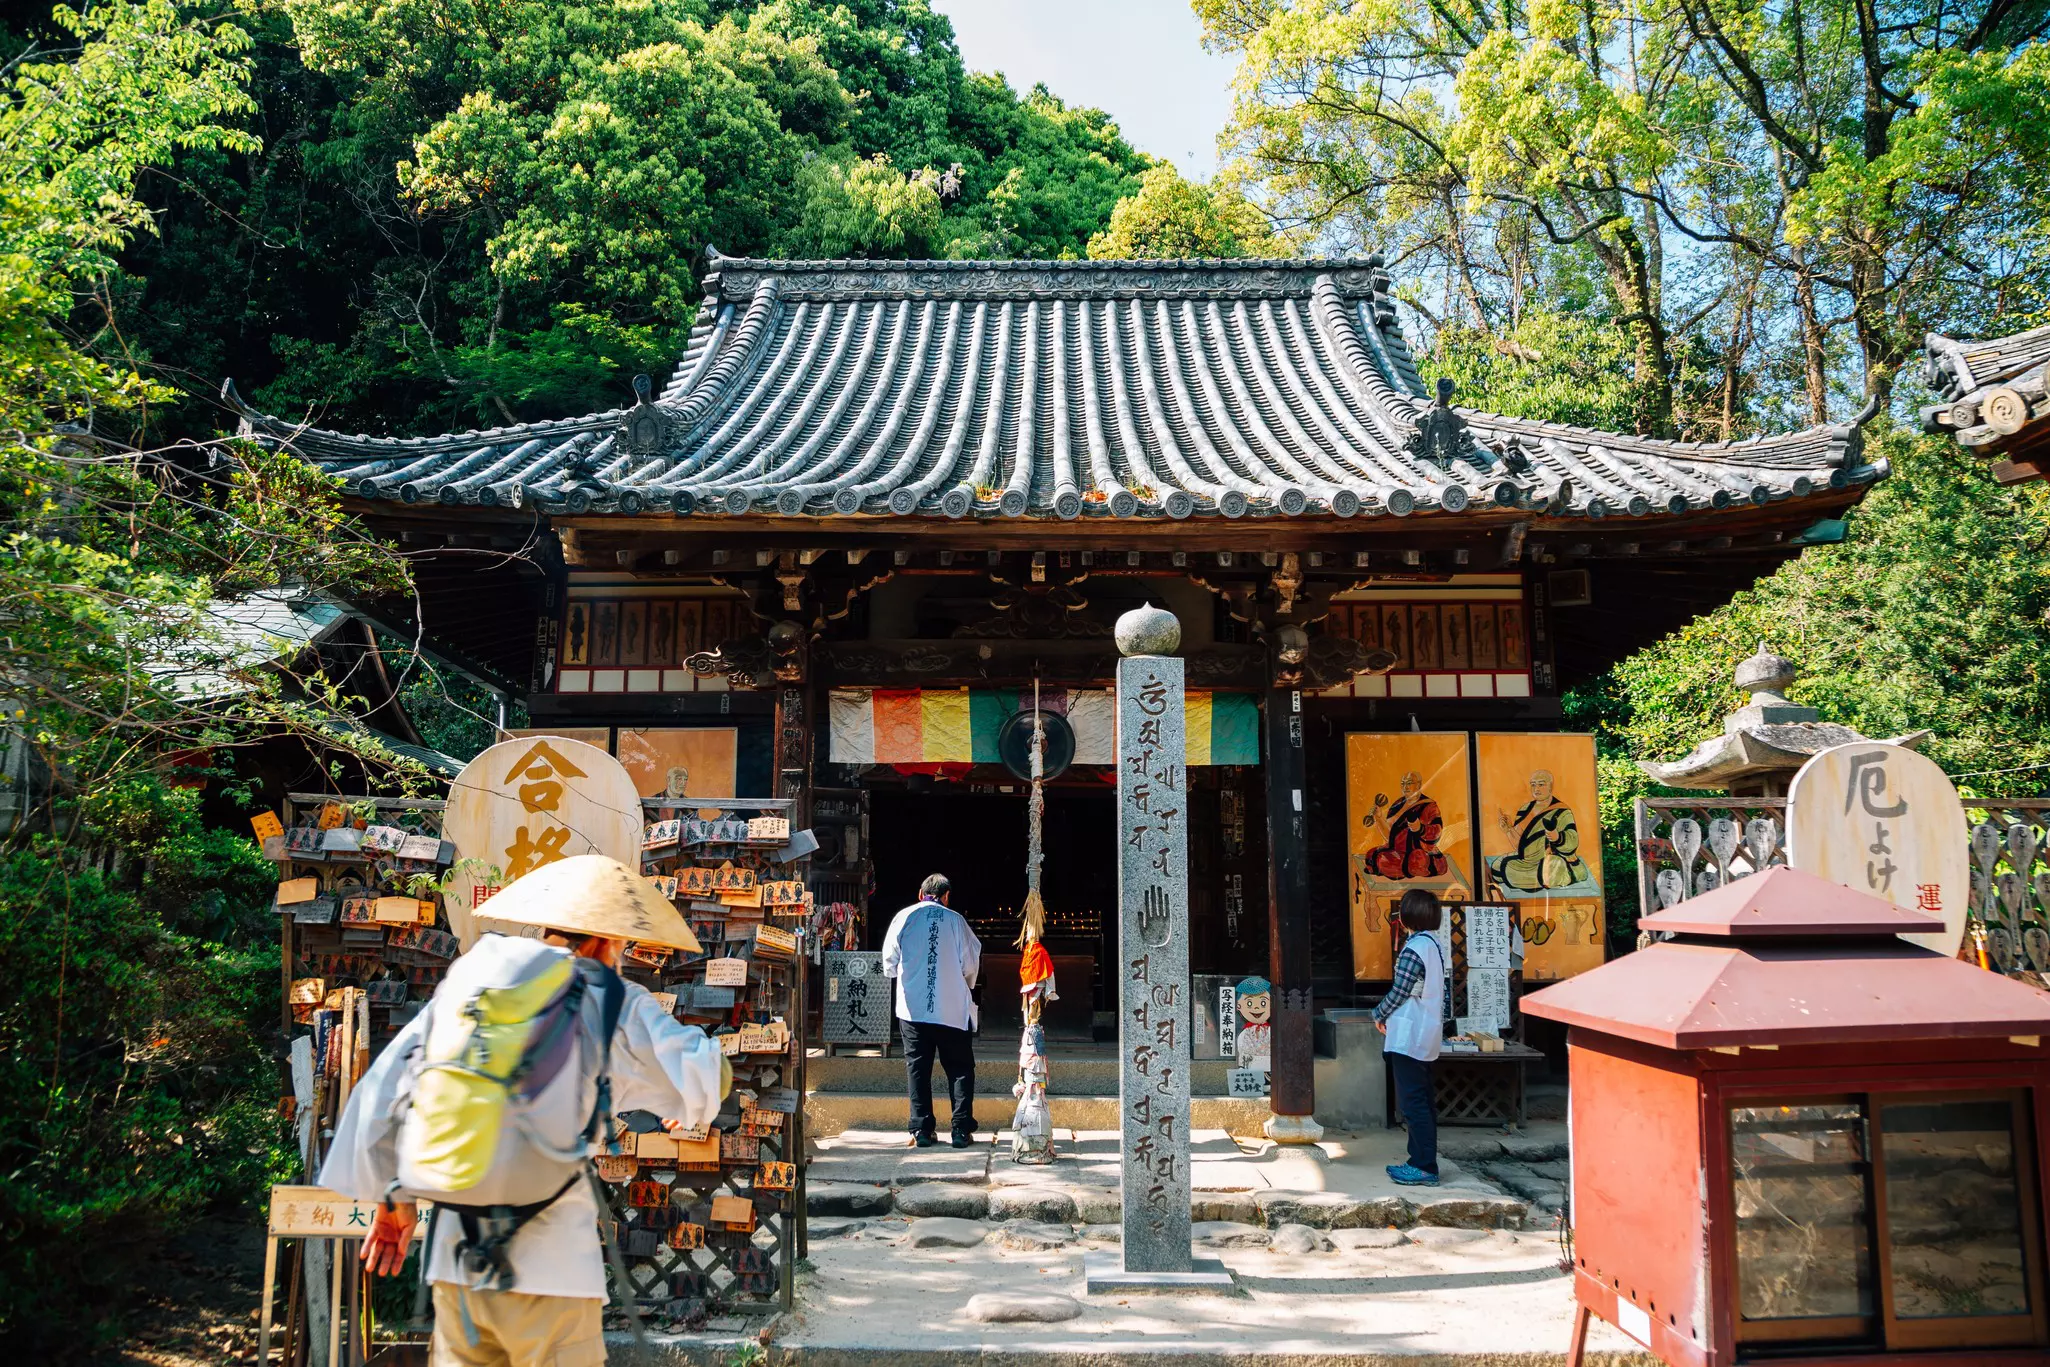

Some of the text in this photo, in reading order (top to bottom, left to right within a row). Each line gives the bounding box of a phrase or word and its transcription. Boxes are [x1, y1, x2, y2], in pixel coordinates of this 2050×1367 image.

[1844, 750, 1908, 894] 厄よけ
[1915, 883, 1943, 911] 運
[1473, 908, 1484, 955] 恵まれます
[1484, 908, 1495, 964] 帰ると子宝に
[1495, 908, 1506, 955] 石を頂いて
[847, 979, 869, 1035] 納札入
[1221, 988, 1234, 1055] 写経奉納箱
[1494, 969, 1507, 1025] 八福神まいり
[1234, 1083, 1262, 1093] 大師堂
[280, 1203, 335, 1229] 奉納
